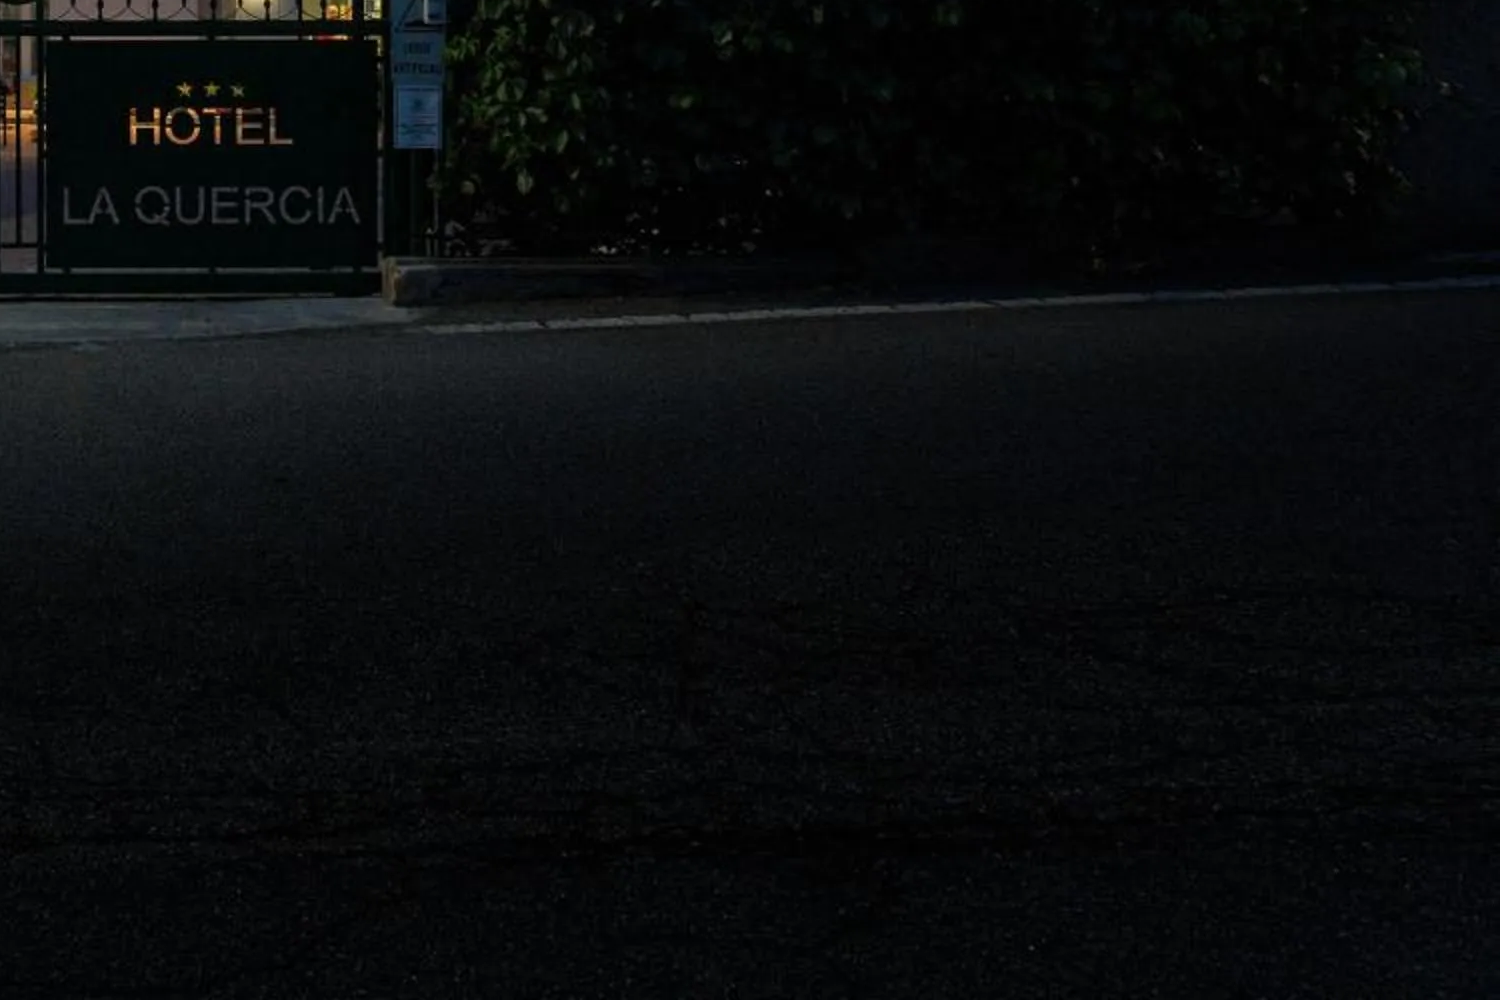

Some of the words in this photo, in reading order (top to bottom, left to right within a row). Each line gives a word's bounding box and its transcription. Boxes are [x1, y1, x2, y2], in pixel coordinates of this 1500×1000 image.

[127, 106, 294, 146] HOTEL
[62, 186, 121, 226] LA
[134, 185, 362, 227] QUERCIA
